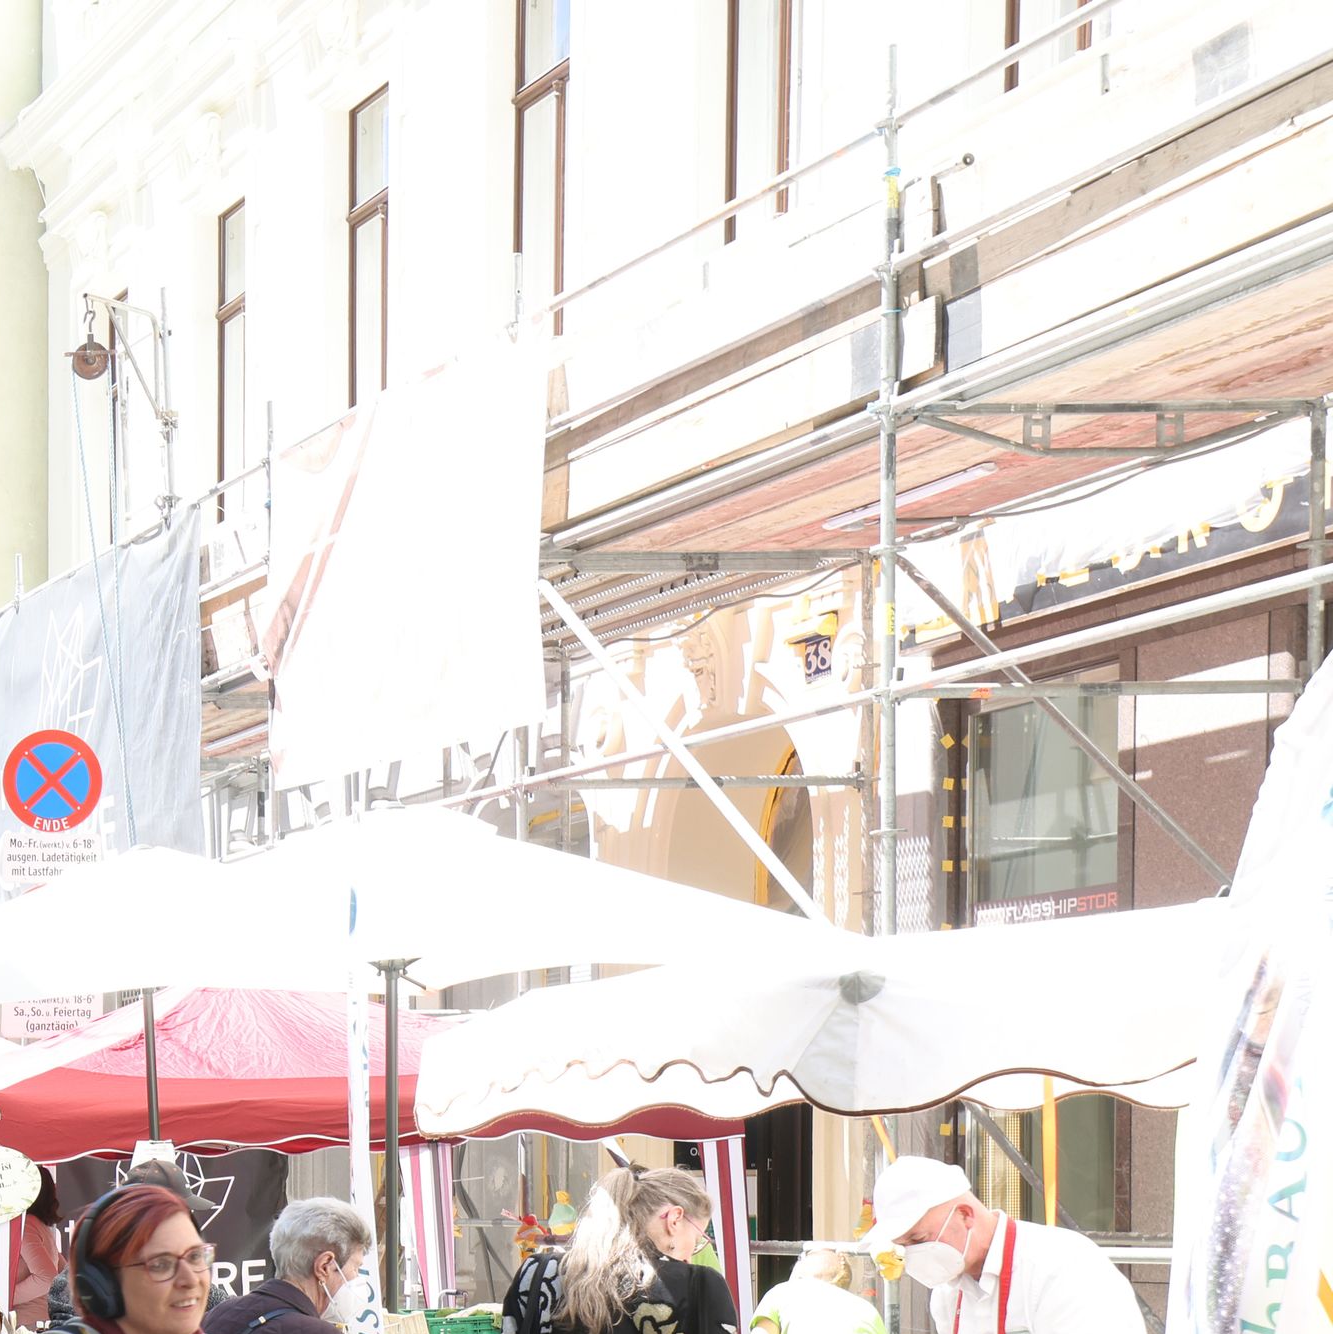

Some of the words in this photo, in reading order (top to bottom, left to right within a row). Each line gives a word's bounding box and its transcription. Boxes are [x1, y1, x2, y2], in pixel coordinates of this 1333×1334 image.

[805, 640, 832, 675] 38
[34, 817, 70, 832] ENDE
[9, 838, 39, 849] Mo.-Fr.
[7, 853, 39, 863] ausgen.
[41, 852, 97, 864] Ladetätigkeit
[11, 866, 26, 877] mit
[53, 1007, 92, 1020] Feiertag
[0, 1161, 13, 1171] ist
